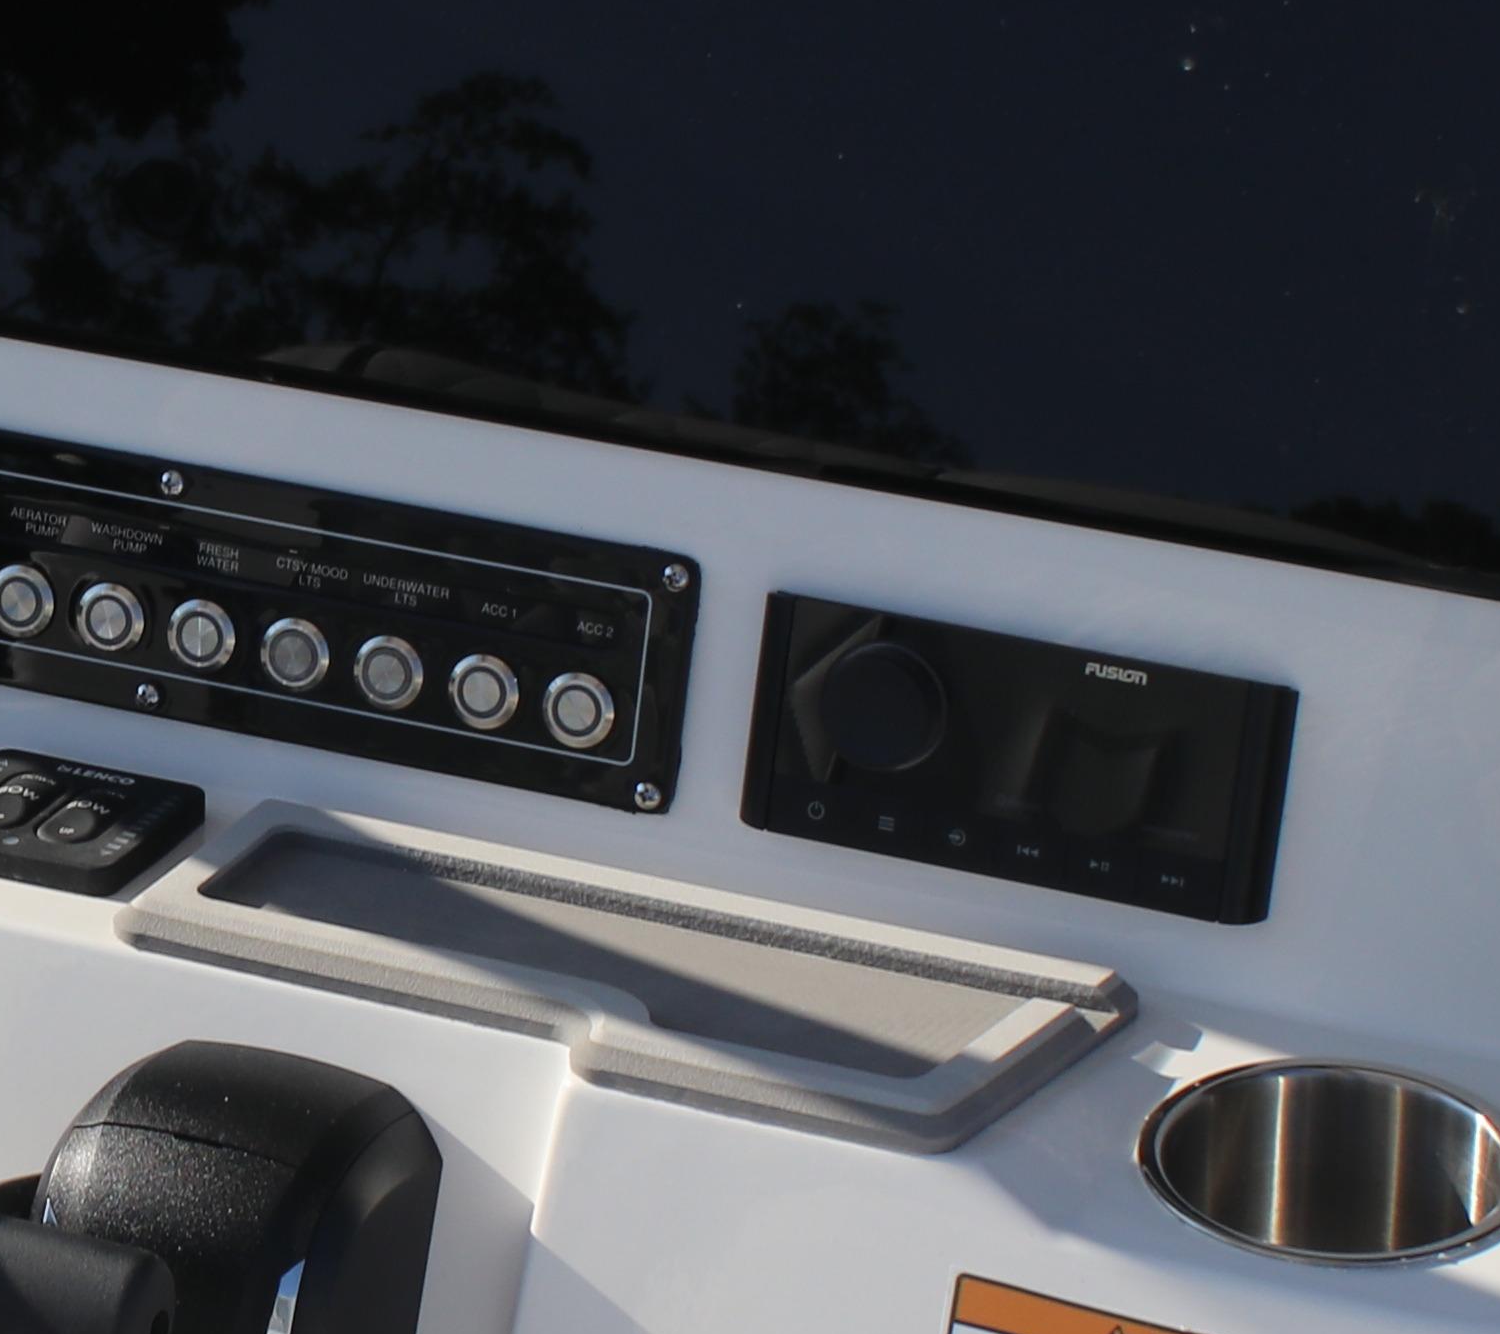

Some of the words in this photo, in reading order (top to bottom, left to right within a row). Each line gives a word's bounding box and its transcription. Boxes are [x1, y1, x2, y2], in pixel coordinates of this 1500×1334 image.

[10, 506, 69, 530] AERATOR
[25, 521, 60, 537] PUMP
[89, 521, 163, 546] WASHDOWN
[112, 538, 148, 554] PUMP
[199, 541, 239, 560] FRESH
[196, 554, 240, 574] WATER
[298, 574, 321, 589] LTS
[363, 573, 450, 600] UNDERWATER
[394, 591, 417, 607] LTS
[481, 602, 508, 618] ACC
[512, 608, 517, 619] 1
[576, 620, 604, 636] ACC
[605, 625, 614, 638] 2
[1084, 661, 1149, 686] FUSION
[72, 766, 136, 786] LENCO
